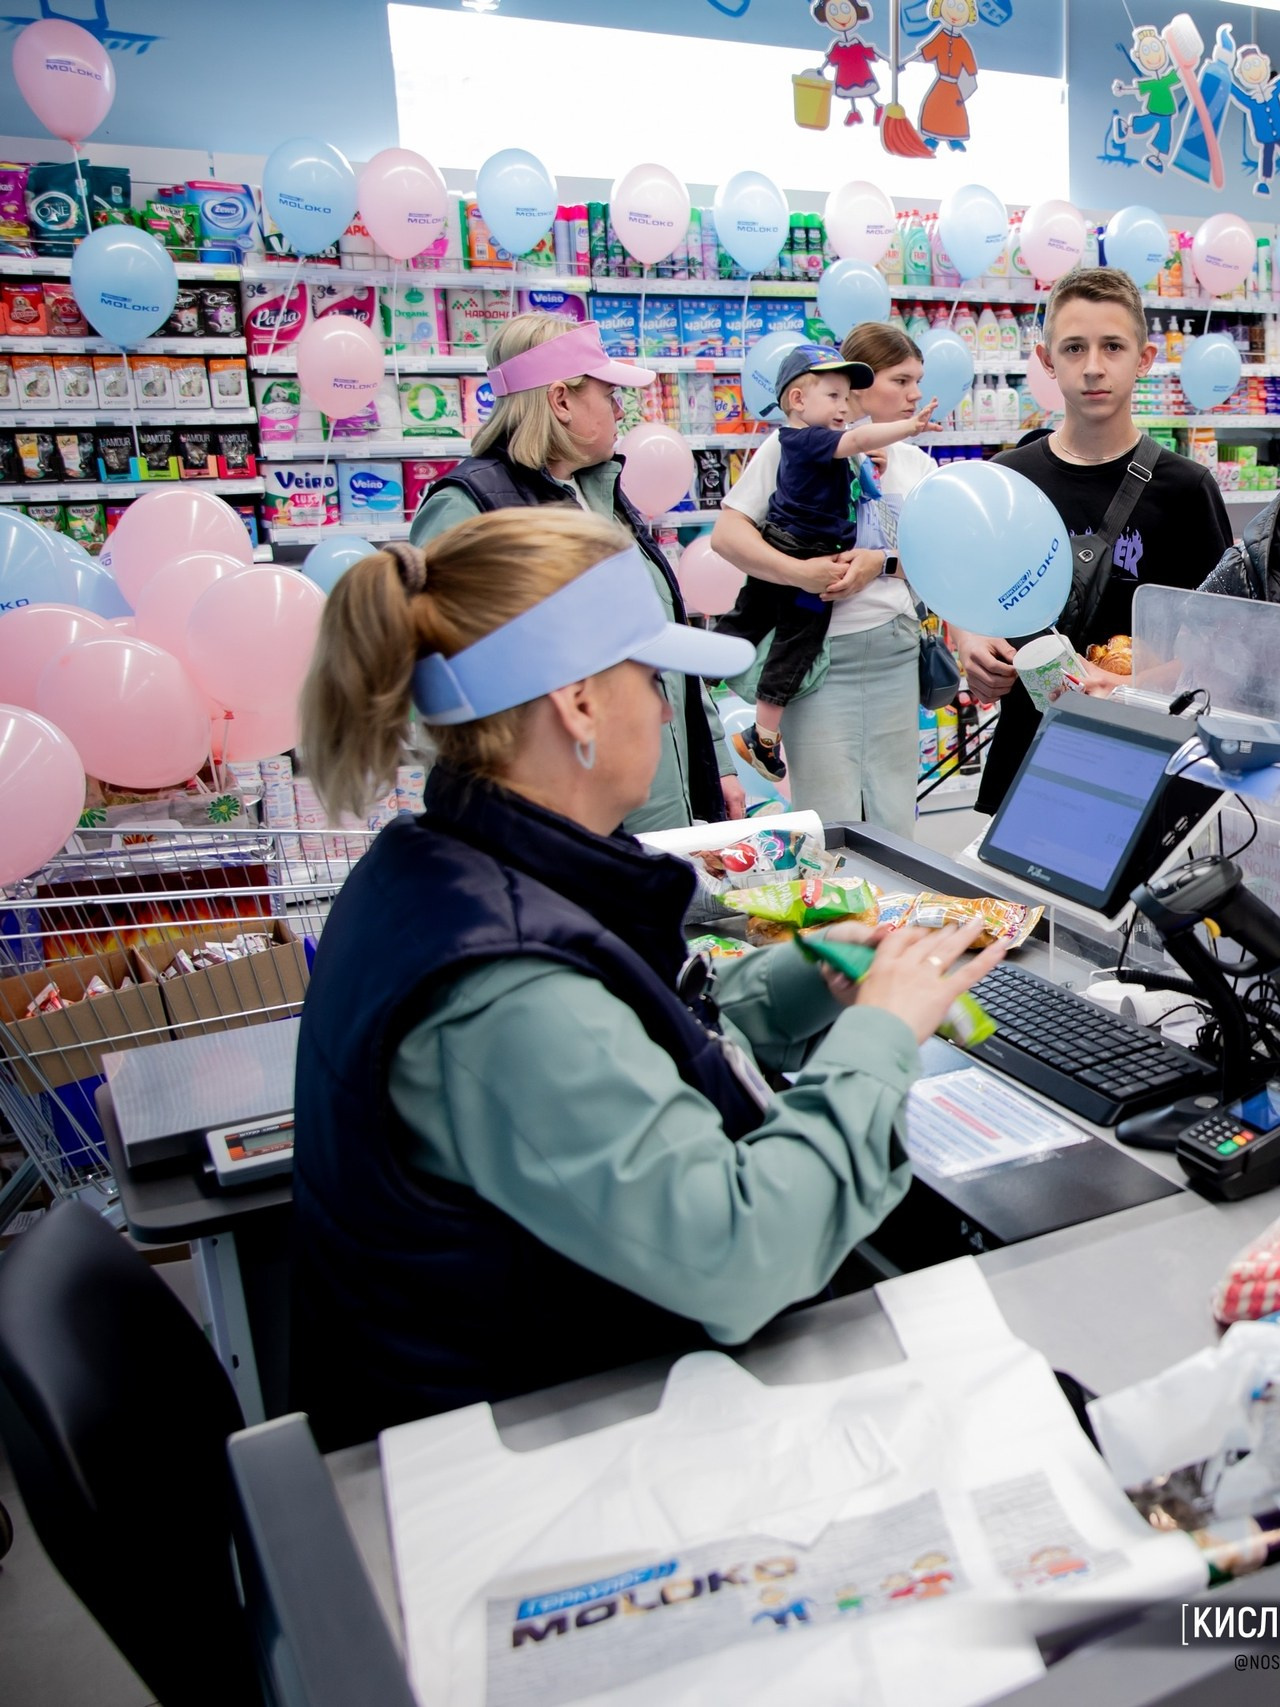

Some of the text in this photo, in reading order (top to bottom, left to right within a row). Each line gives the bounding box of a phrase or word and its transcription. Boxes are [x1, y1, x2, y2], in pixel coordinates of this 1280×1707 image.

[45, 62, 103, 82] MOLOKO
[214, 204, 238, 215] Zewa
[278, 198, 332, 215] MOLOKO
[628, 215, 674, 228] MOLOKO
[736, 225, 779, 233] MOLOKO
[100, 297, 160, 313] MOLOKO
[532, 292, 564, 304] Veiro
[254, 308, 301, 331] Papia
[639, 315, 677, 331] чайка
[684, 316, 722, 332] чайка
[726, 316, 764, 332] чайка
[767, 316, 805, 332] чайка
[332, 382, 378, 391] MOLOKO
[751, 373, 776, 394] MOLO
[274, 470, 335, 490] Veiro
[352, 479, 384, 490] Veiro
[1003, 538, 1059, 611] MOLOKO
[511, 1556, 799, 1649] MOLOKO
